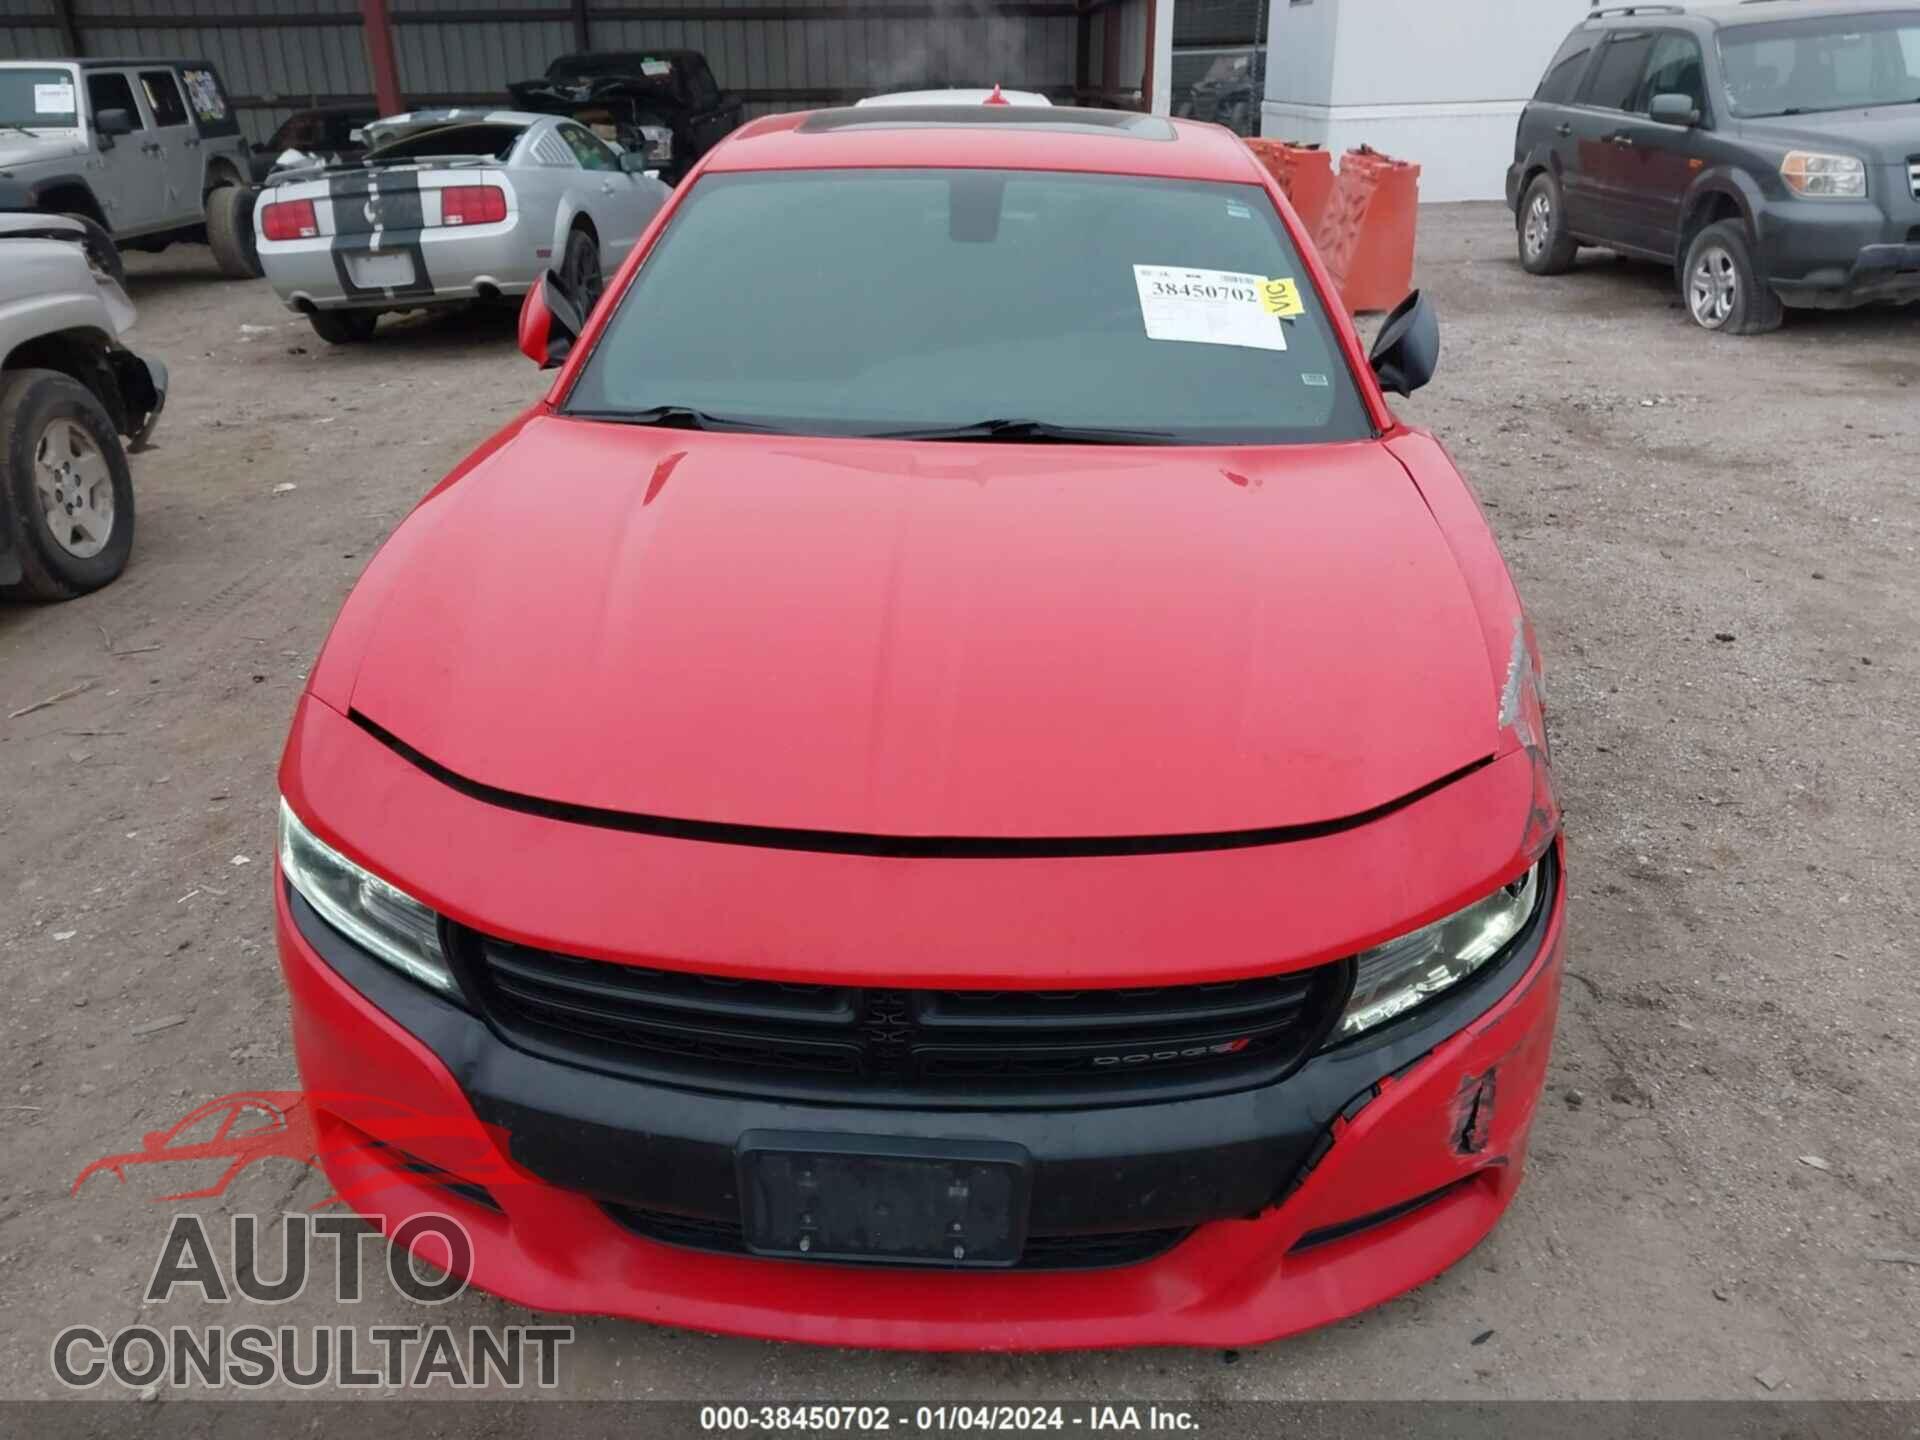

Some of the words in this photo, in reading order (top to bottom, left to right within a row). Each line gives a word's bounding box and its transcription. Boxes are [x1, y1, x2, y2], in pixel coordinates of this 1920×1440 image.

[1152, 281, 1257, 303] 38450702
[1265, 282, 1291, 313] VIC
[1092, 1042, 1230, 1066] DODGE
